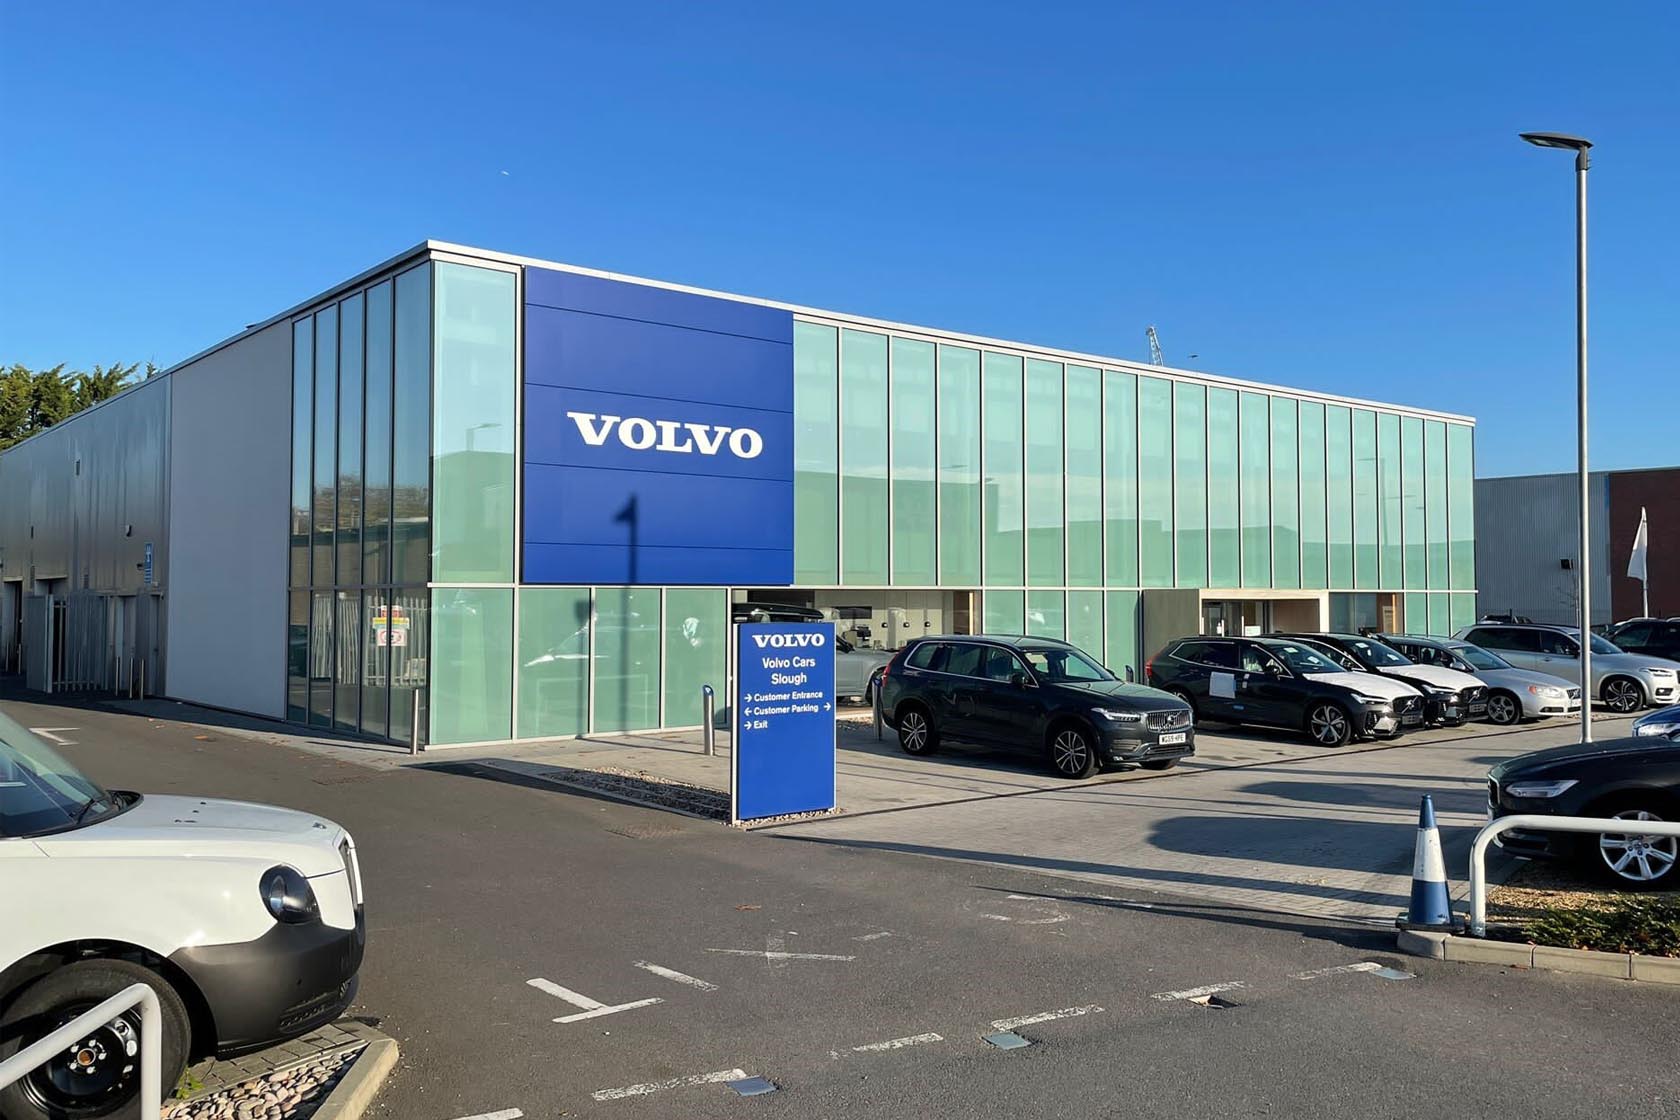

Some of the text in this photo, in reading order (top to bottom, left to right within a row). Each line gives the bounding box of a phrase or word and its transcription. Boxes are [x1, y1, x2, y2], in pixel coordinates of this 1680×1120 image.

[567, 411, 763, 459] VOLVO
[752, 633, 825, 648] VOLVO
[762, 656, 816, 669] Volvo Cars
[771, 672, 807, 685] Slough
[754, 691, 823, 702] Customer Entrance
[754, 704, 819, 716] Customer Parking
[753, 720, 768, 729] Exit
